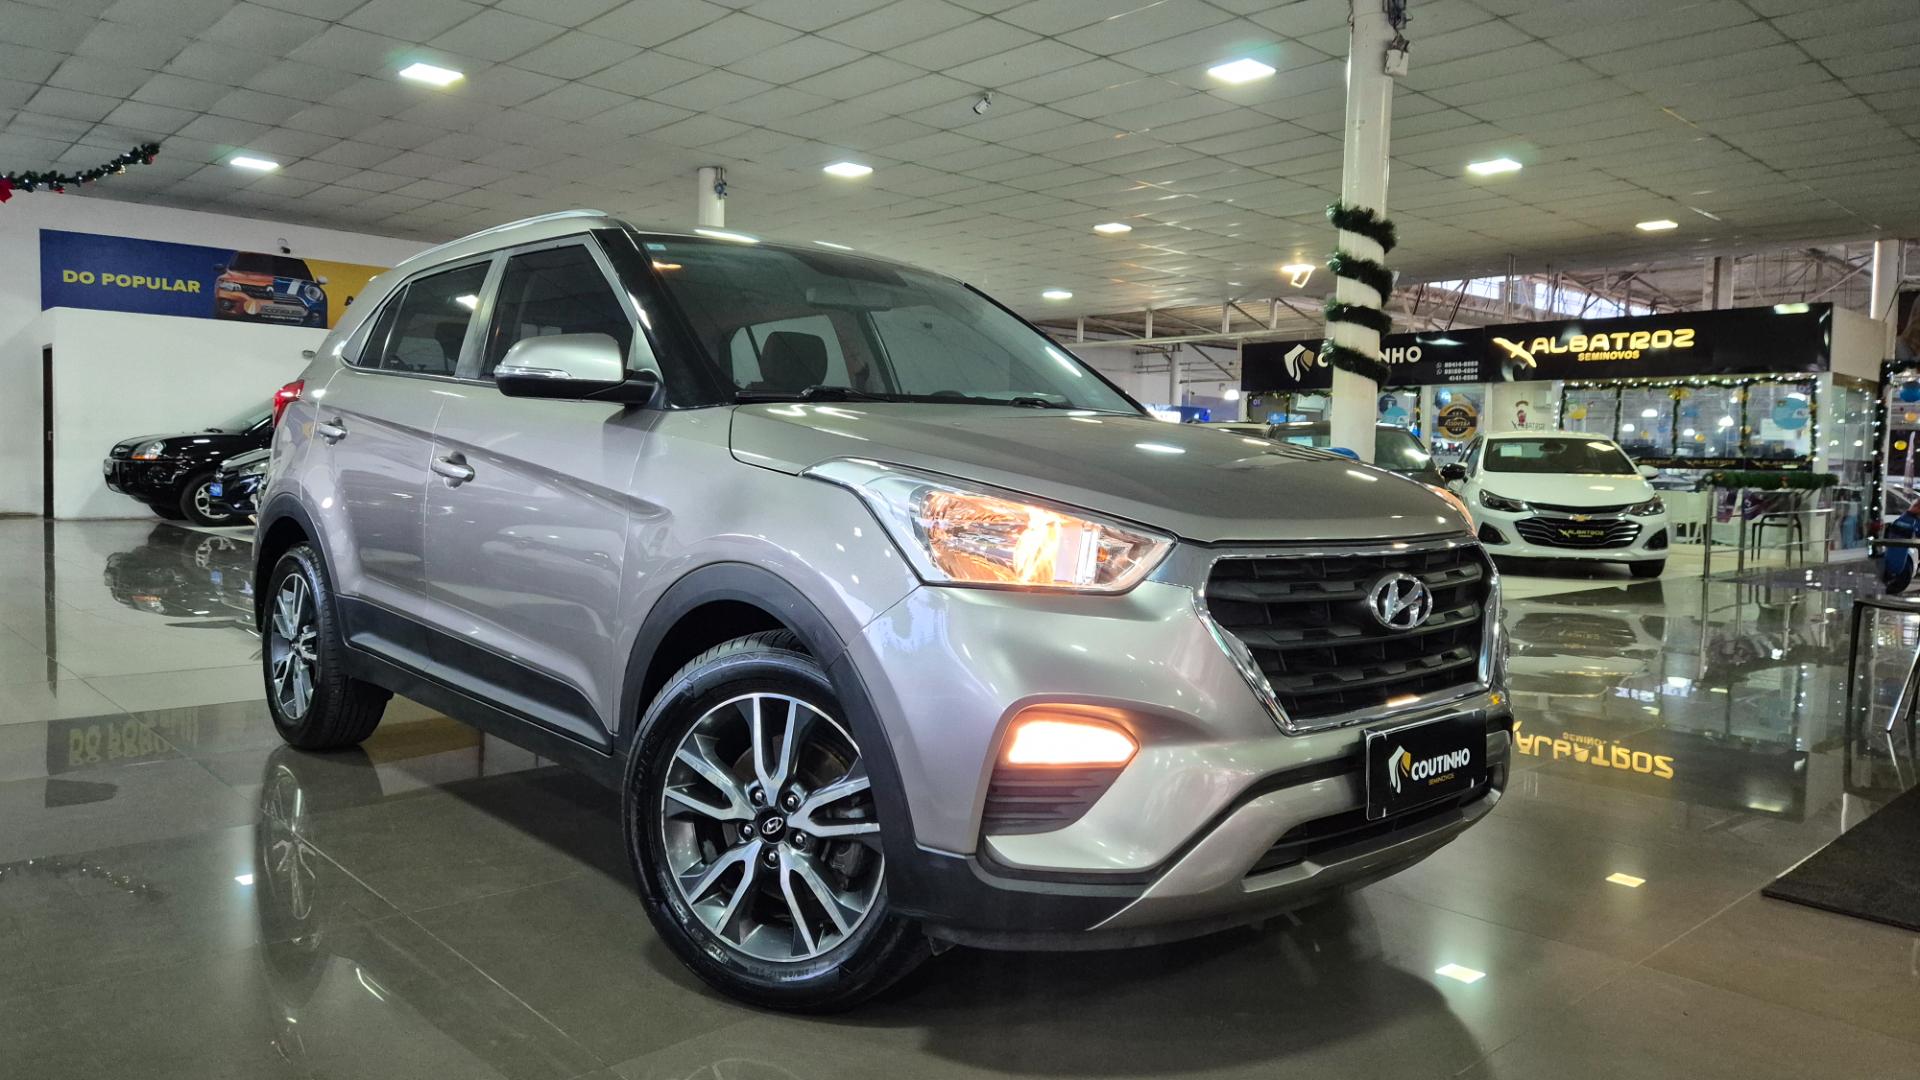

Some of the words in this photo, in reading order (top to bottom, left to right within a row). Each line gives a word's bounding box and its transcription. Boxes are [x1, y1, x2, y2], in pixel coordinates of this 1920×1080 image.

[62, 270, 95, 284] DO
[101, 272, 200, 293] POPULAR
[1530, 328, 1695, 355] ALBATROZ
[1577, 350, 1640, 361] SEMINOVOS
[1411, 748, 1470, 781] COUTINHO
